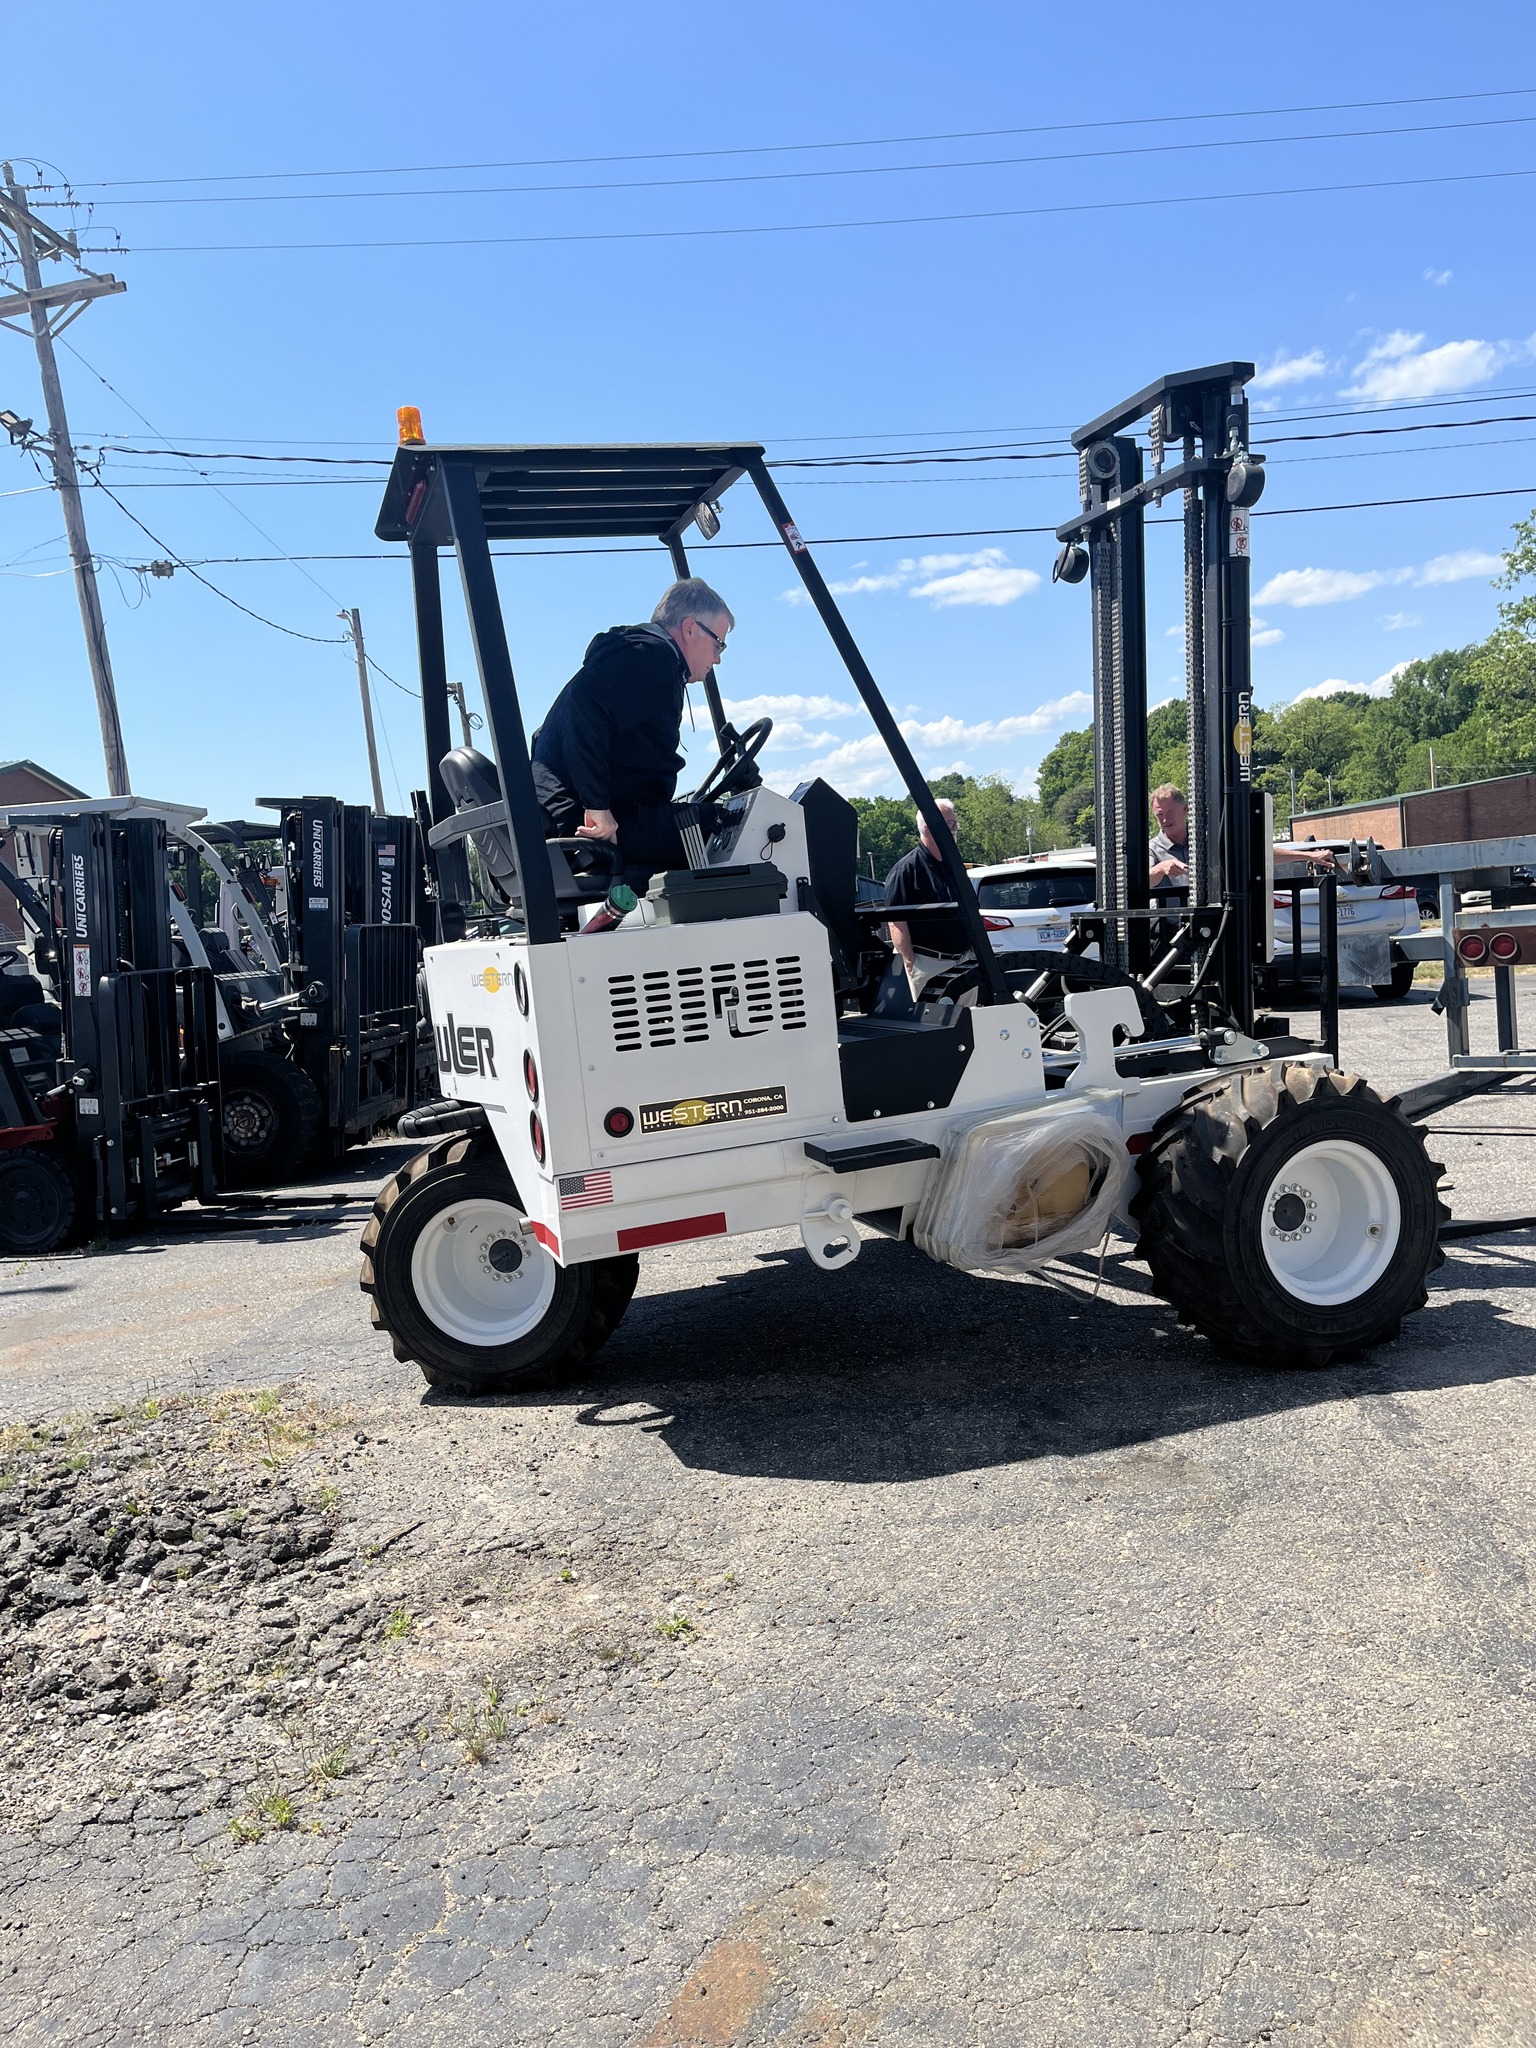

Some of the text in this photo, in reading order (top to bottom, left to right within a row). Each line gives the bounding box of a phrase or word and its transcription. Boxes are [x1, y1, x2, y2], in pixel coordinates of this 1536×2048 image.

[1238, 691, 1251, 782] WESTERN
[312, 819, 323, 888] UNICARRIERS
[73, 854, 88, 939] UNICARRIERS
[471, 972, 515, 987] WESTERN
[642, 1099, 743, 1126] WESTERN
[743, 1095, 773, 1104] CORONA,
